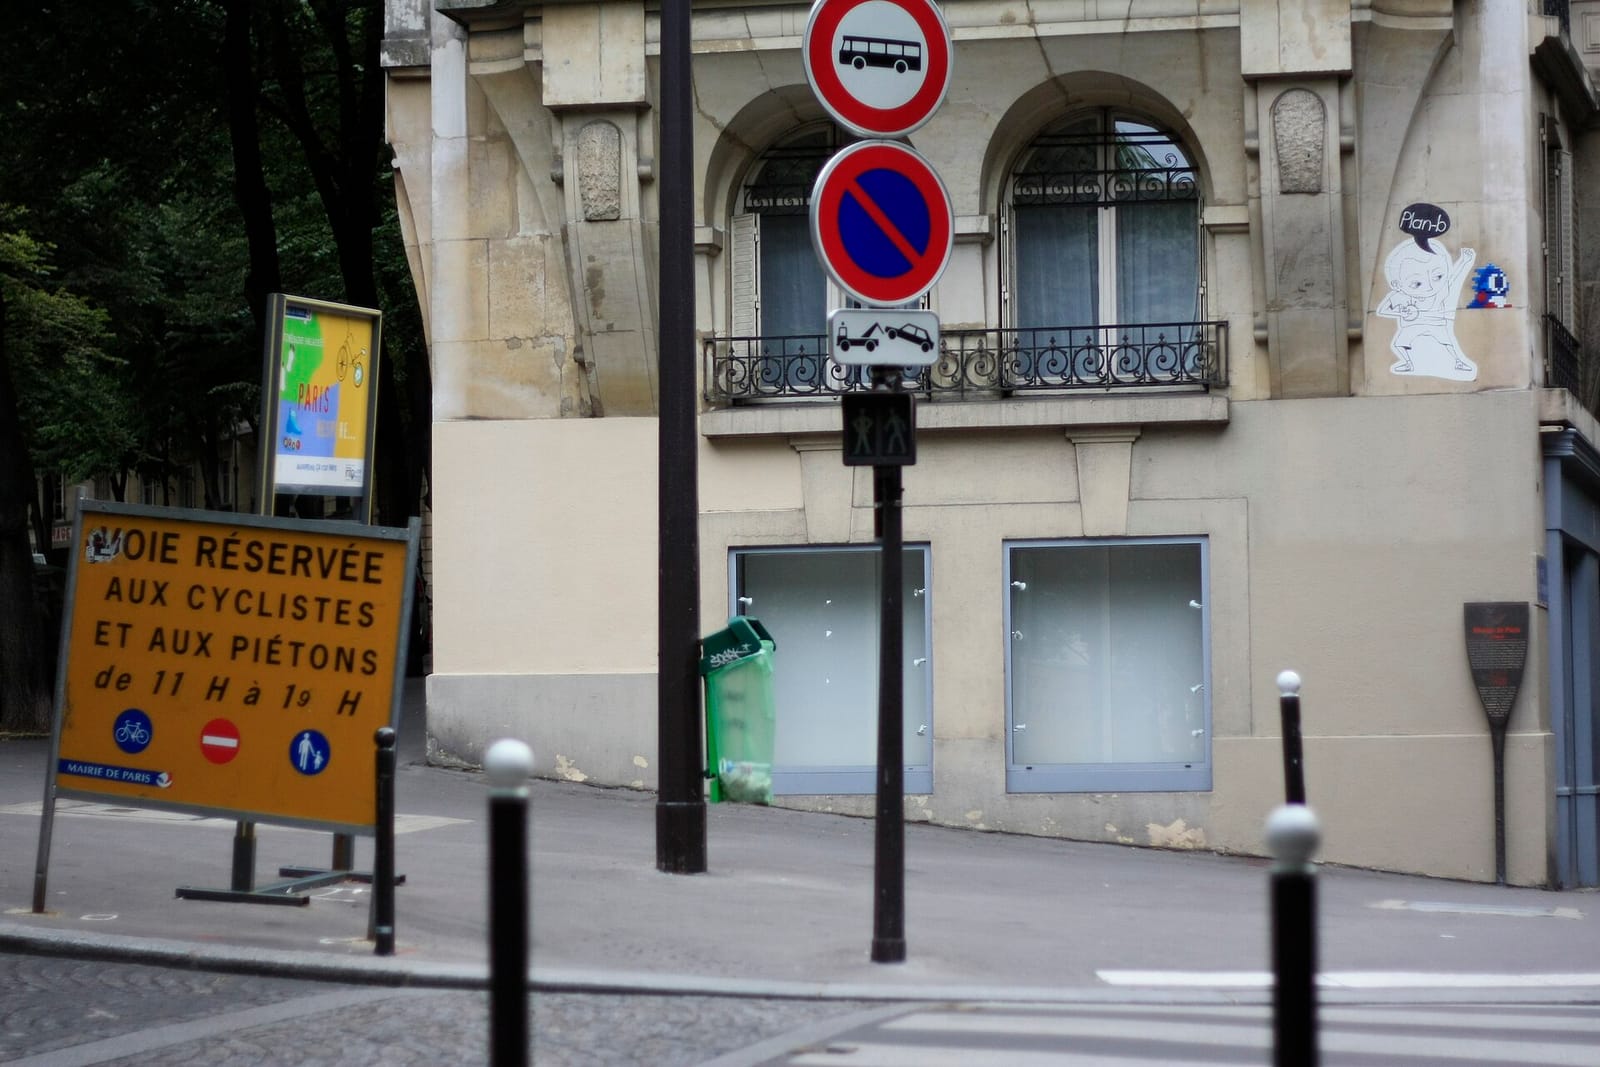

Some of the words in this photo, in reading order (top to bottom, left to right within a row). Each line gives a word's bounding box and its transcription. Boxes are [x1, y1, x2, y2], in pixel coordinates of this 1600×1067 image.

[1400, 211, 1447, 233] Plan-b
[195, 530, 385, 585] RÉSERVÉE
[105, 576, 169, 607] AUX
[187, 584, 376, 628] CYCLISTES
[94, 620, 133, 649] ET
[148, 627, 213, 658] AUX
[230, 634, 378, 676] PIÉTONS
[94, 665, 132, 691] de
[152, 670, 185, 697] 11
[205, 676, 230, 702] H
[243, 680, 261, 706] à
[283, 684, 311, 709] 19
[337, 690, 362, 716] H
[67, 763, 104, 777] MAIRIE
[105, 768, 120, 779] DE
[122, 770, 151, 784] PARIS
